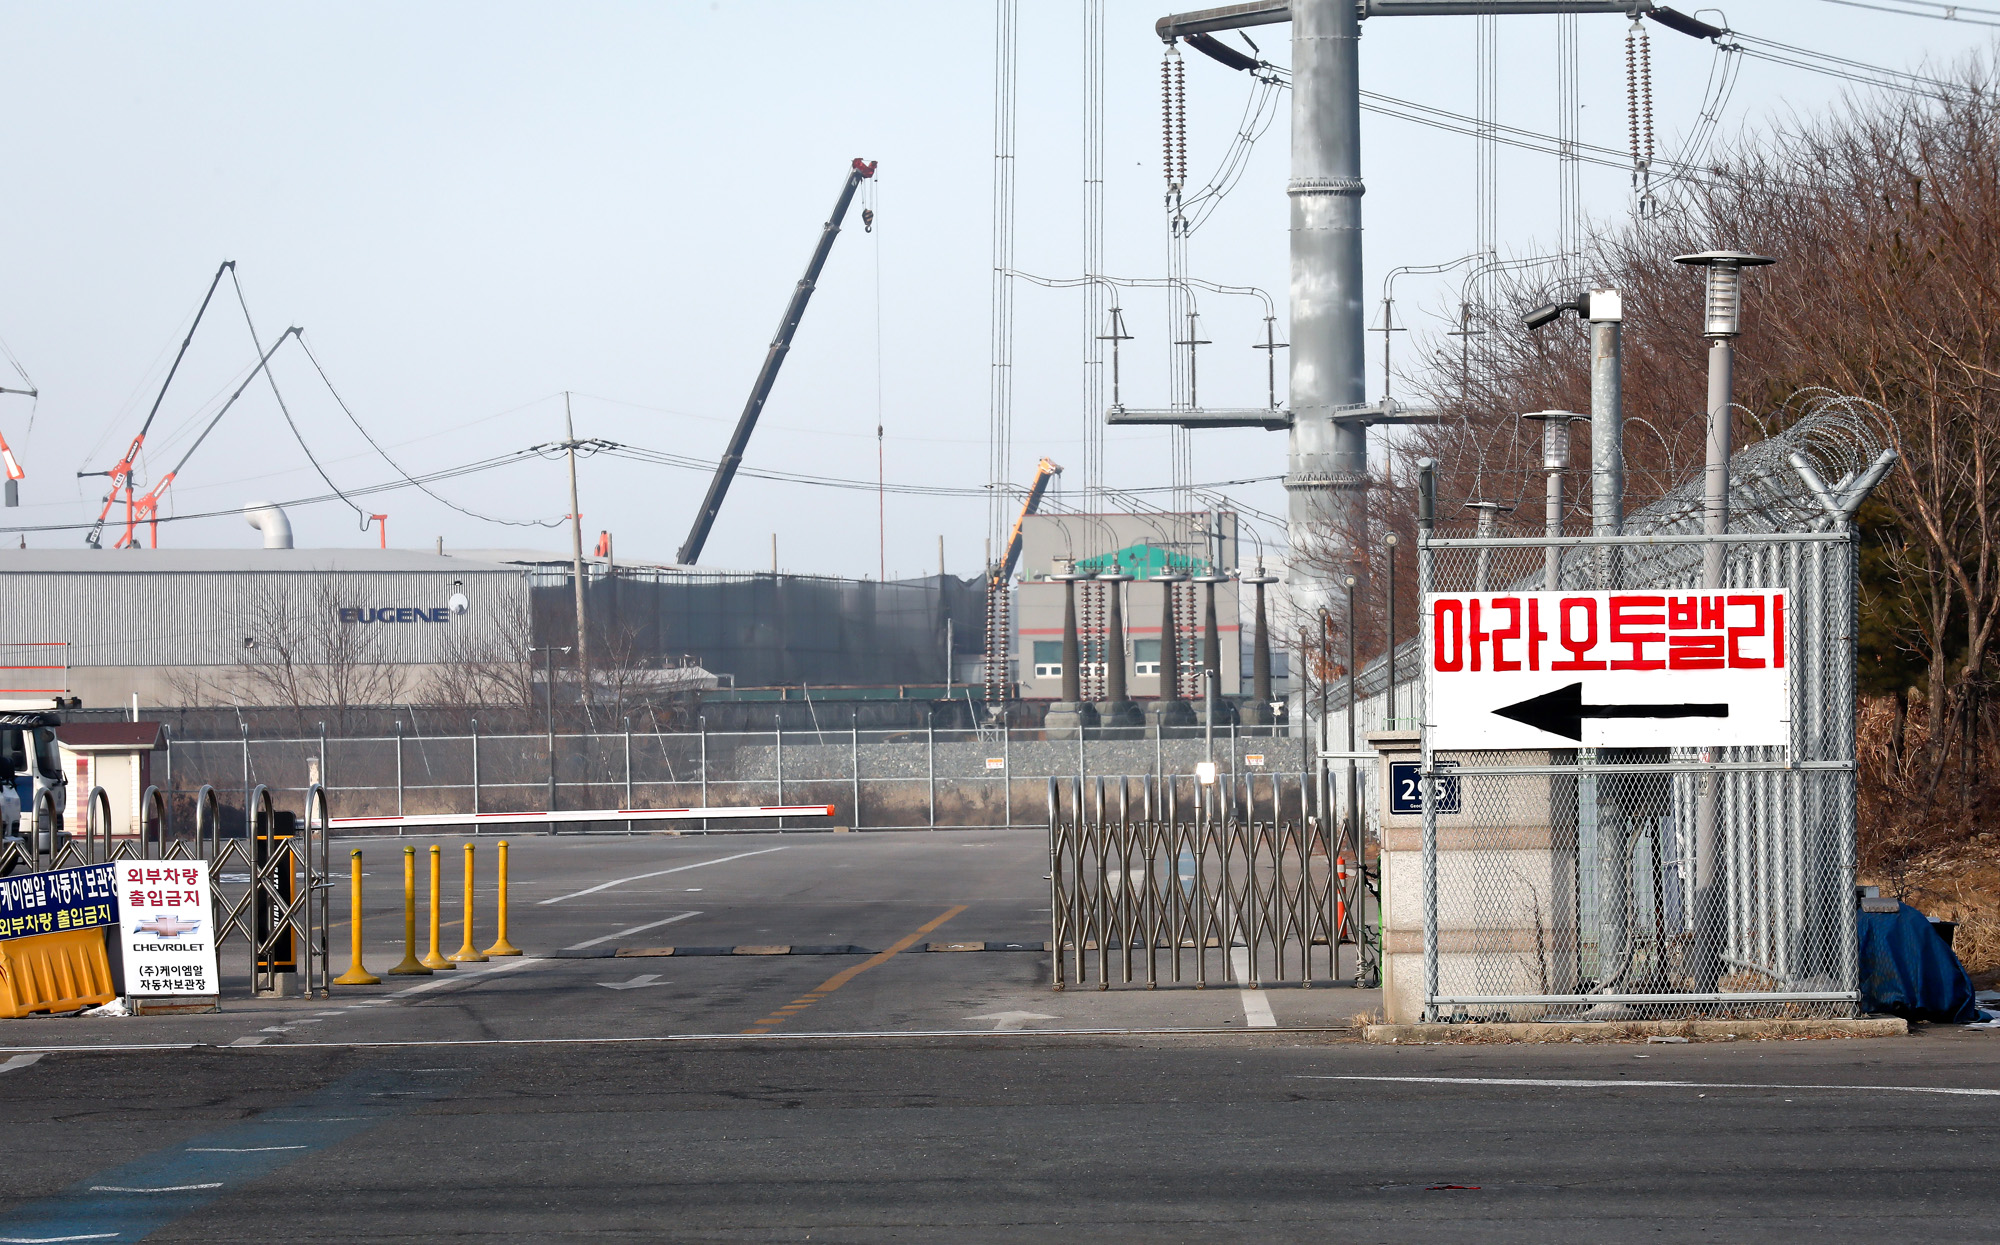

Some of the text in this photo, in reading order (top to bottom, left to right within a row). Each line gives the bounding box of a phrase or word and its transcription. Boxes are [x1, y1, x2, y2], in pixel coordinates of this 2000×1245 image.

[339, 607, 449, 624] EUGENE
[1433, 593, 1784, 673] 아라오토밸리
[127, 868, 199, 885] 외부차량
[48, 870, 84, 904] 자동차
[129, 890, 200, 907] 출입금지
[0, 904, 111, 936] 외부차량 출입금지
[132, 943, 205, 952] CHEVROLET
[139, 965, 203, 977] (주)케이엠알
[140, 979, 206, 991] 자동차보관장
